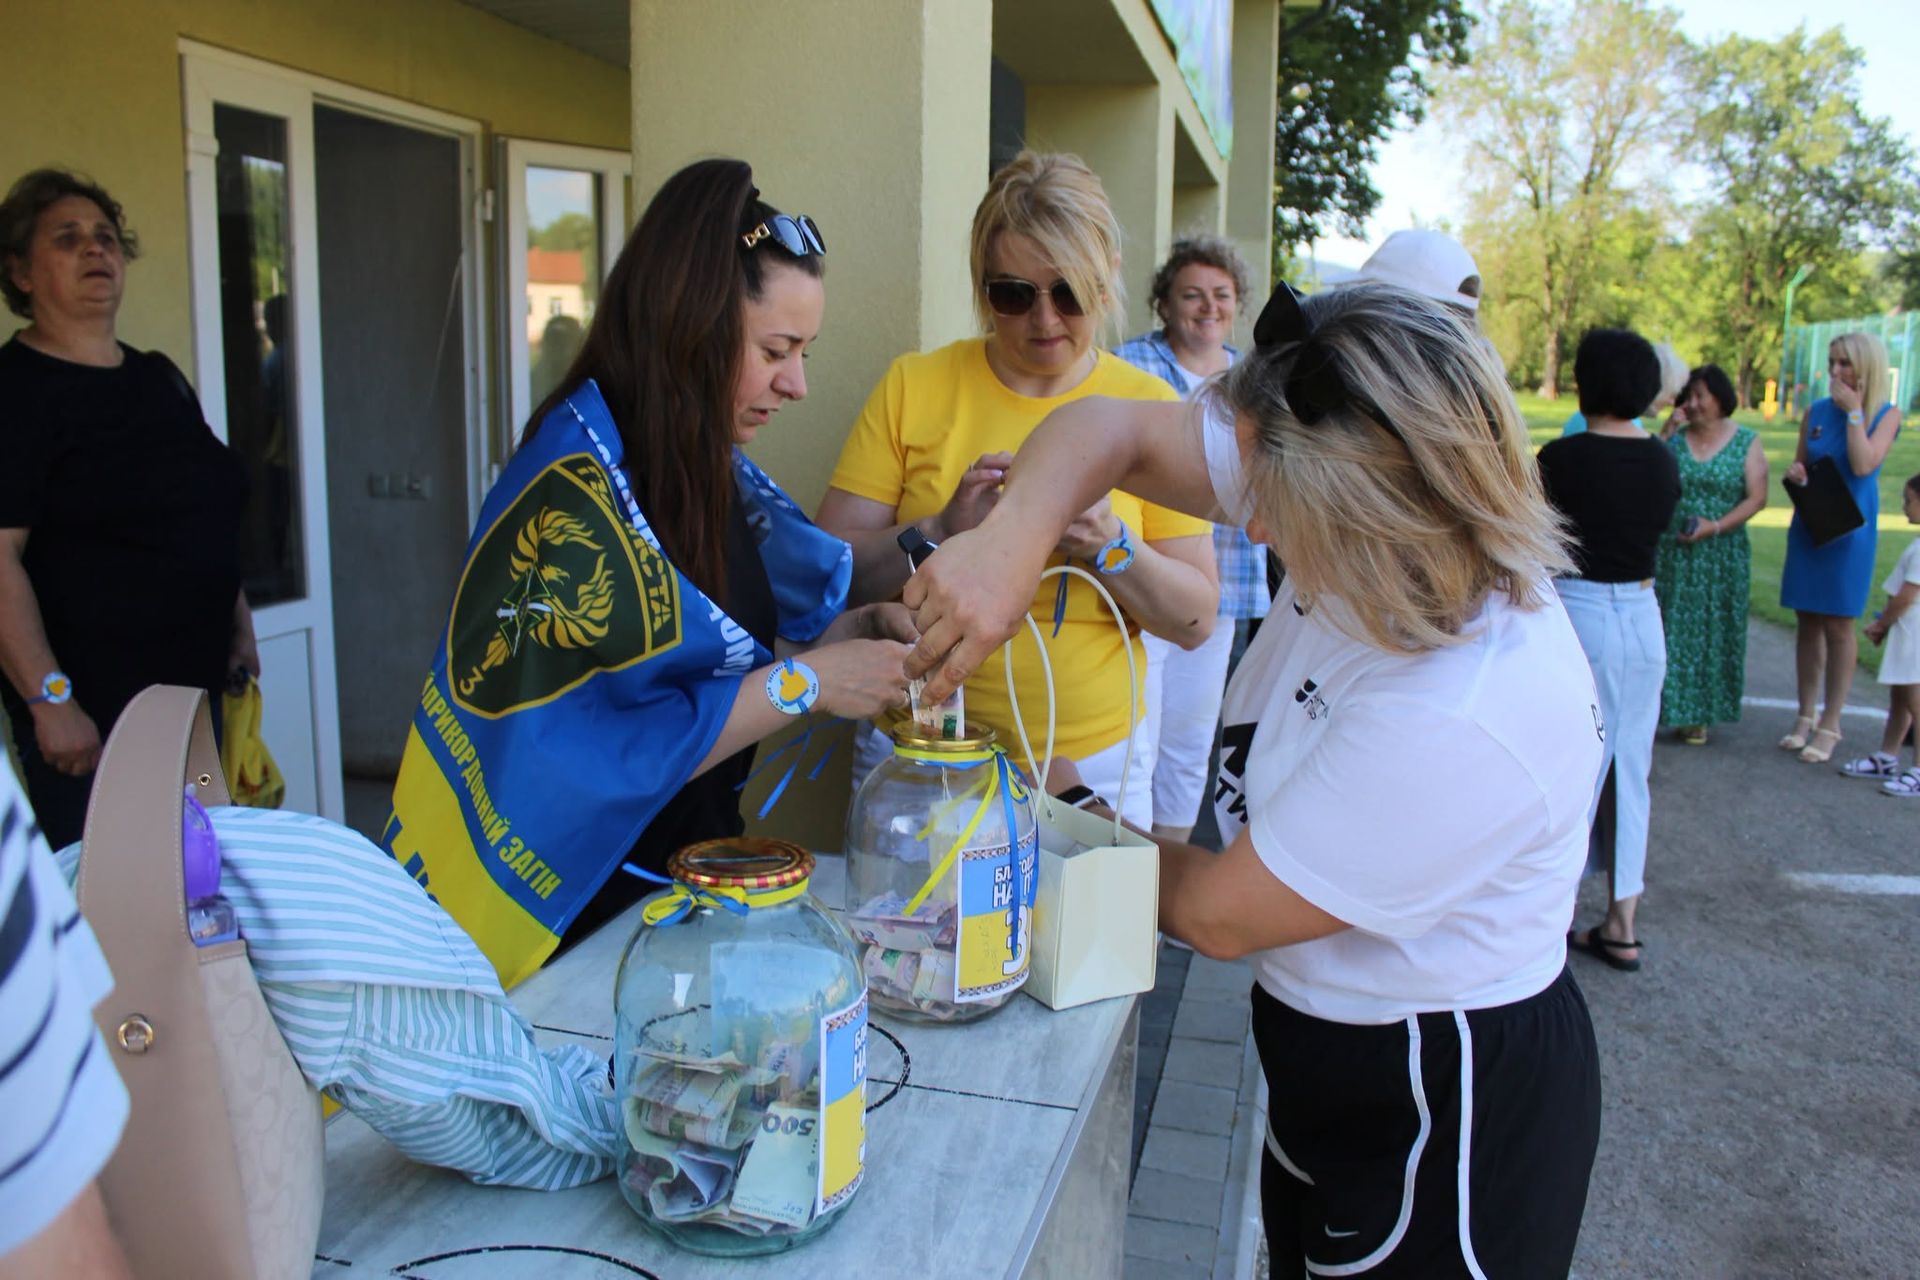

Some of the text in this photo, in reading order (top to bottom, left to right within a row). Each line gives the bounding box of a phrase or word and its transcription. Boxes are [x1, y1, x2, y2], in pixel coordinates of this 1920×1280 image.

[459, 665, 485, 697] 3
[421, 685, 563, 901] ПРИКОРДОННИЙ ЗАГІН
[761, 1112, 817, 1137] 500
